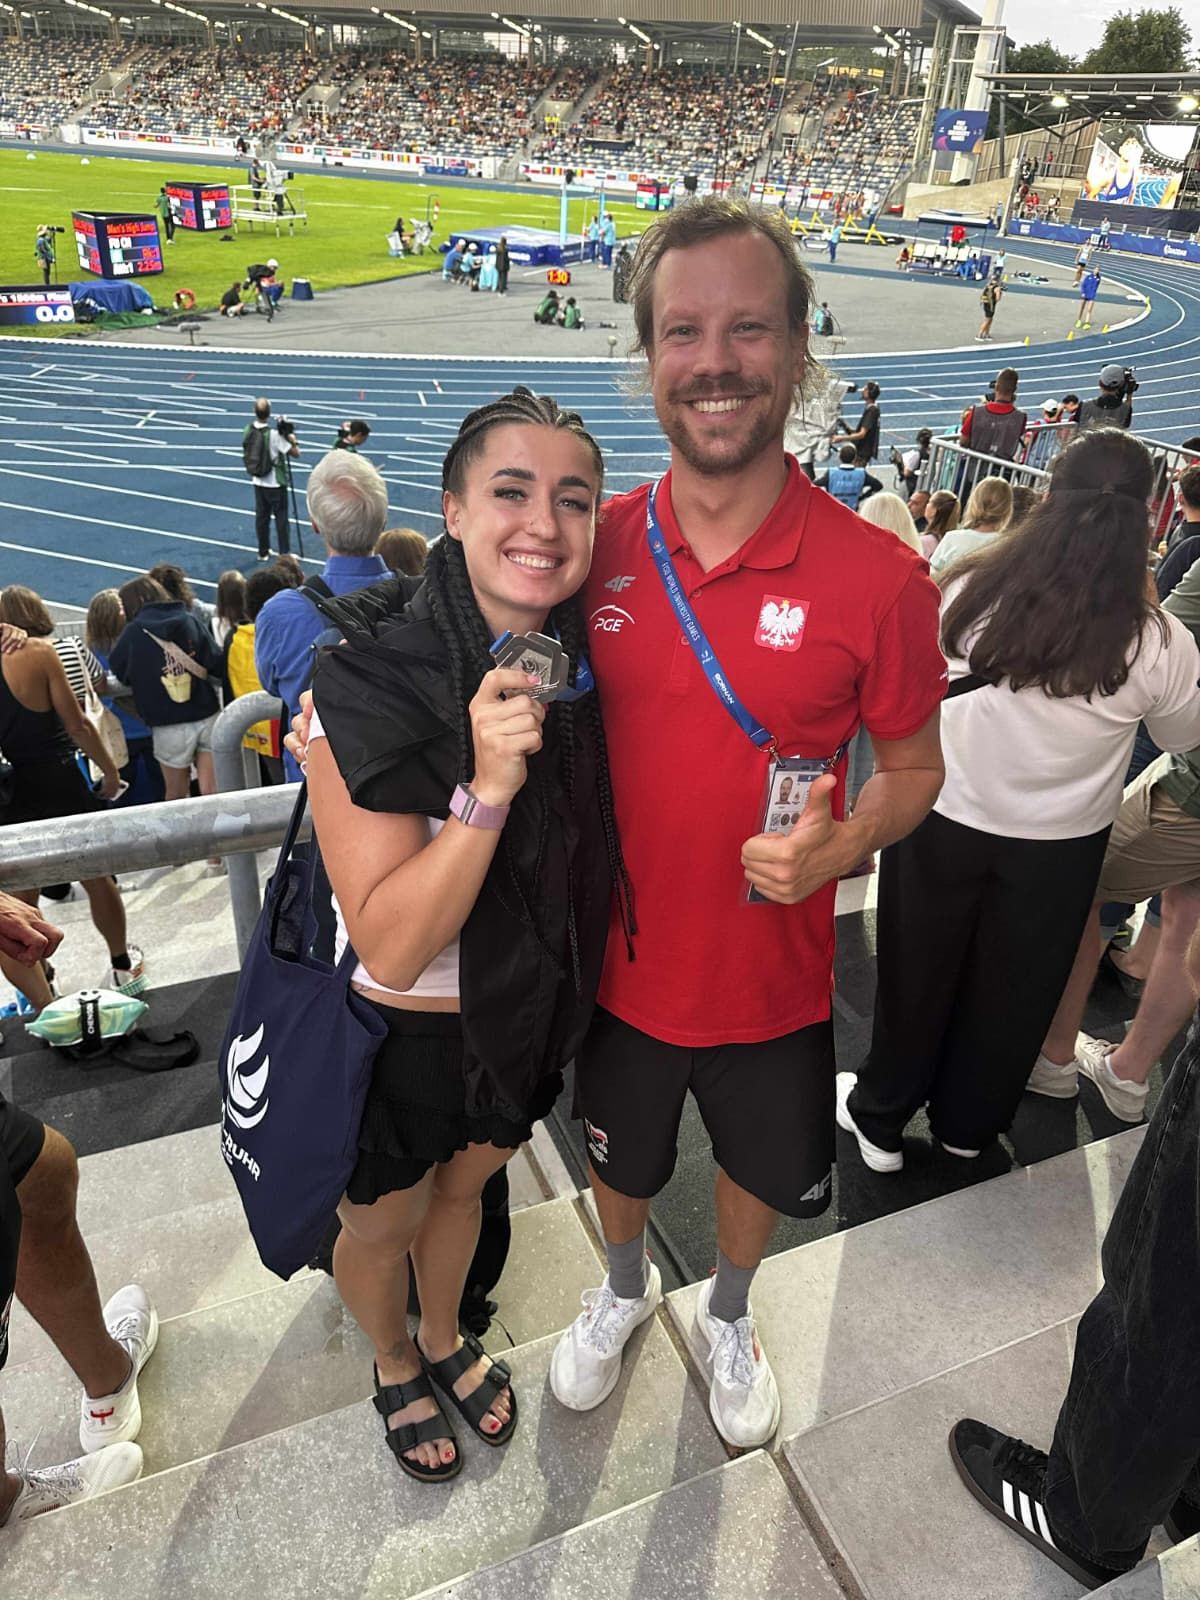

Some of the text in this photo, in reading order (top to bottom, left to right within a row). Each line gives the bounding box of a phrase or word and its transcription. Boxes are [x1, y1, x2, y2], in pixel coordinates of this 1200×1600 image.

[36, 305, 75, 322] 0.0
[604, 575, 637, 592] 4F
[665, 574, 678, 594] WORLD
[673, 590, 691, 624] UNIVERSITY
[686, 621, 700, 641] GAMES
[594, 618, 624, 632] PGE
[799, 1171, 832, 1201] 4F
